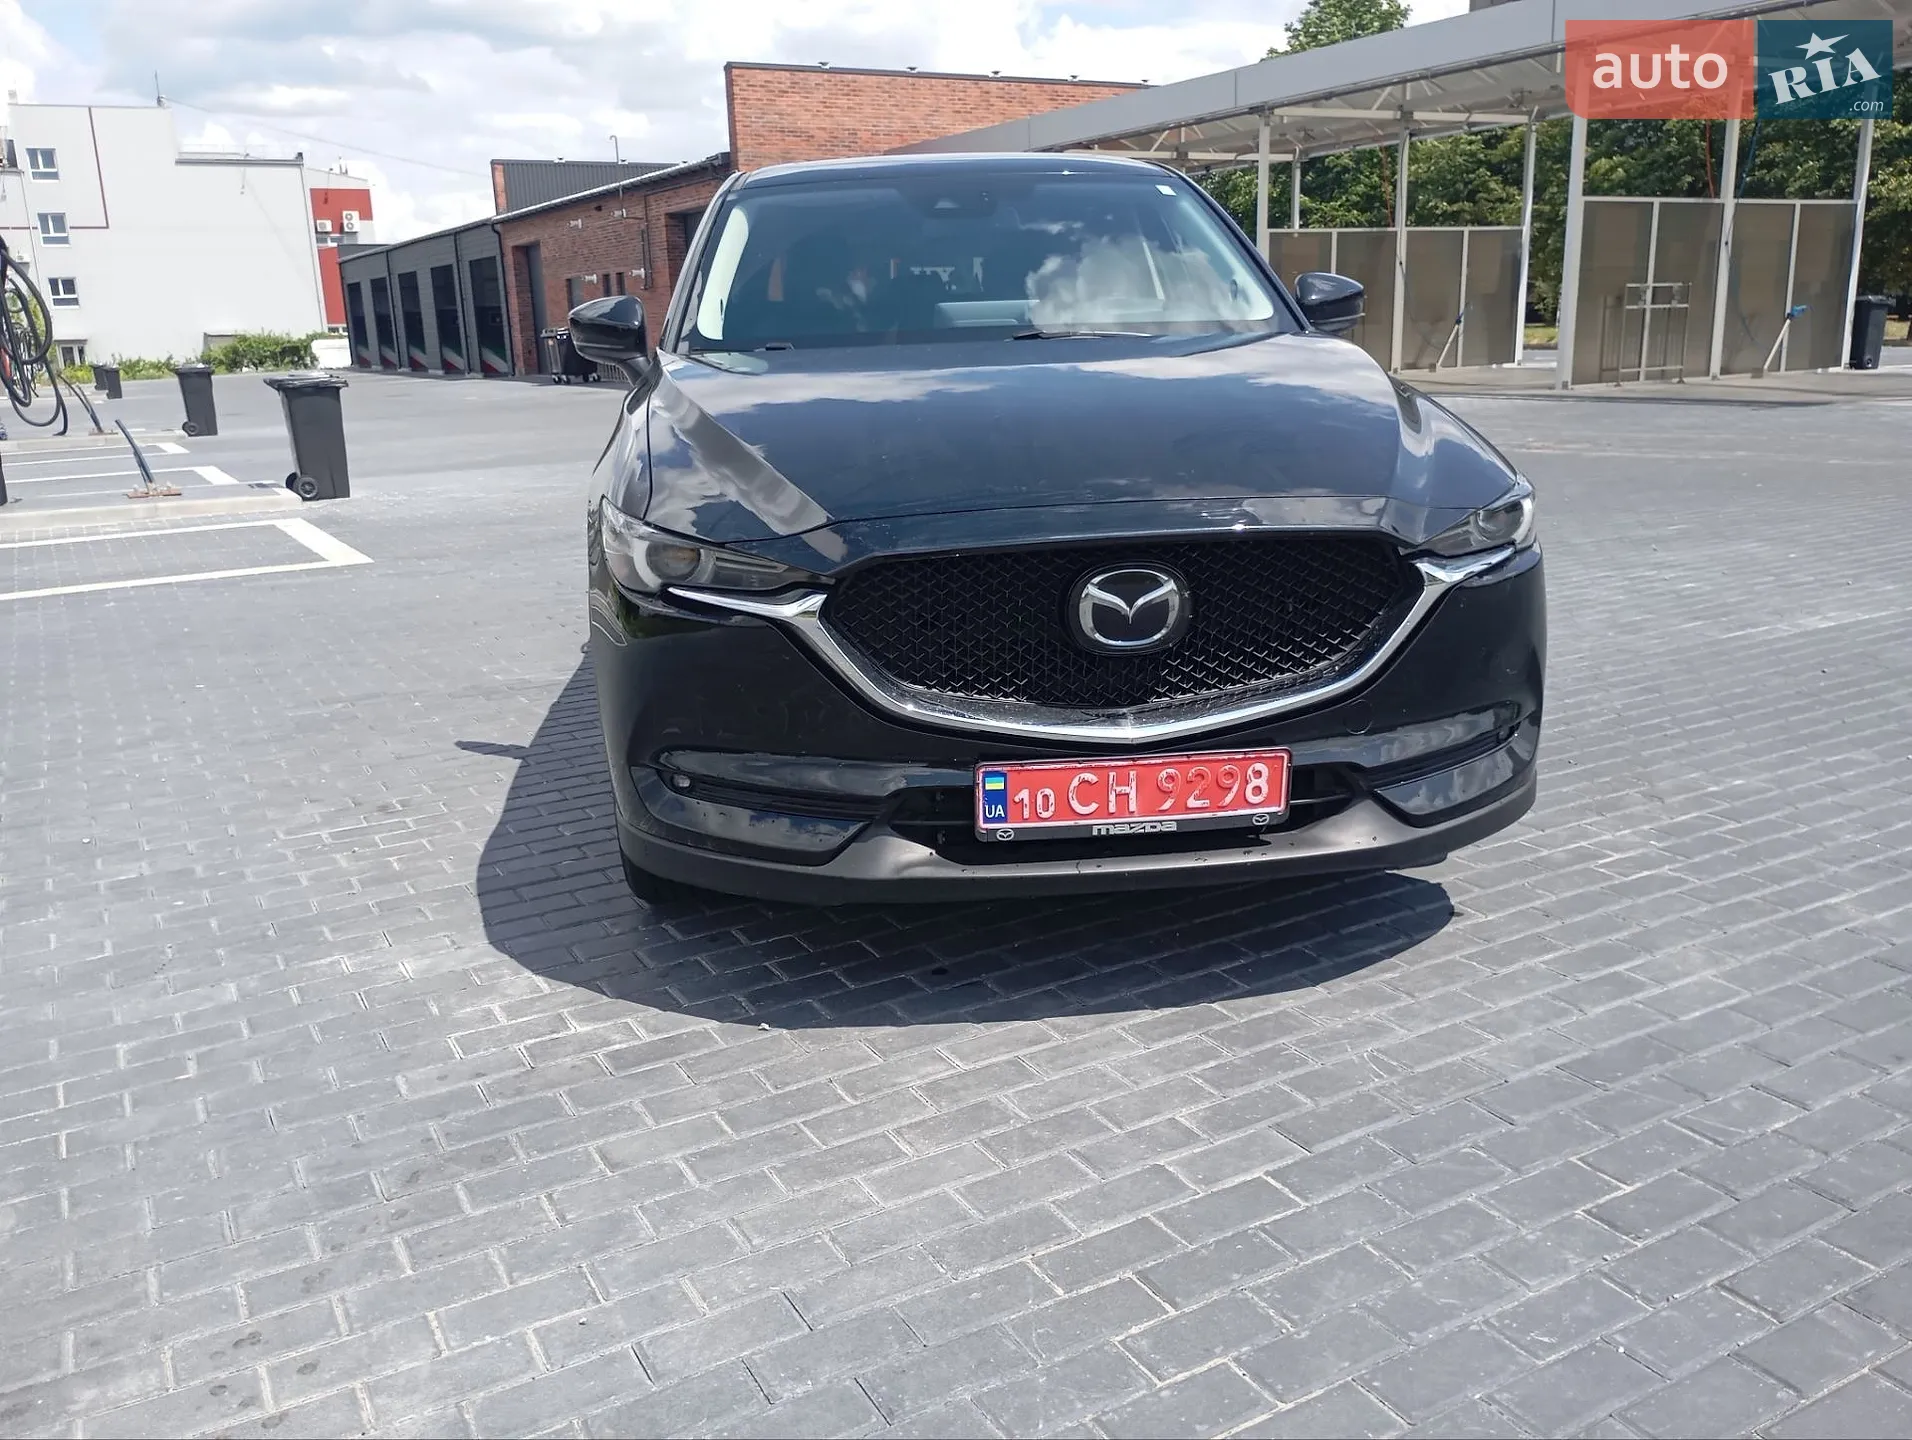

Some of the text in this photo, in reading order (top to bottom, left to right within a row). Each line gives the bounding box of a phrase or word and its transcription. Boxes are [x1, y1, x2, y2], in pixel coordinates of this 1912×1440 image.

[1013, 762, 1269, 819] 10 CH 9298
[984, 804, 1005, 818] UA
